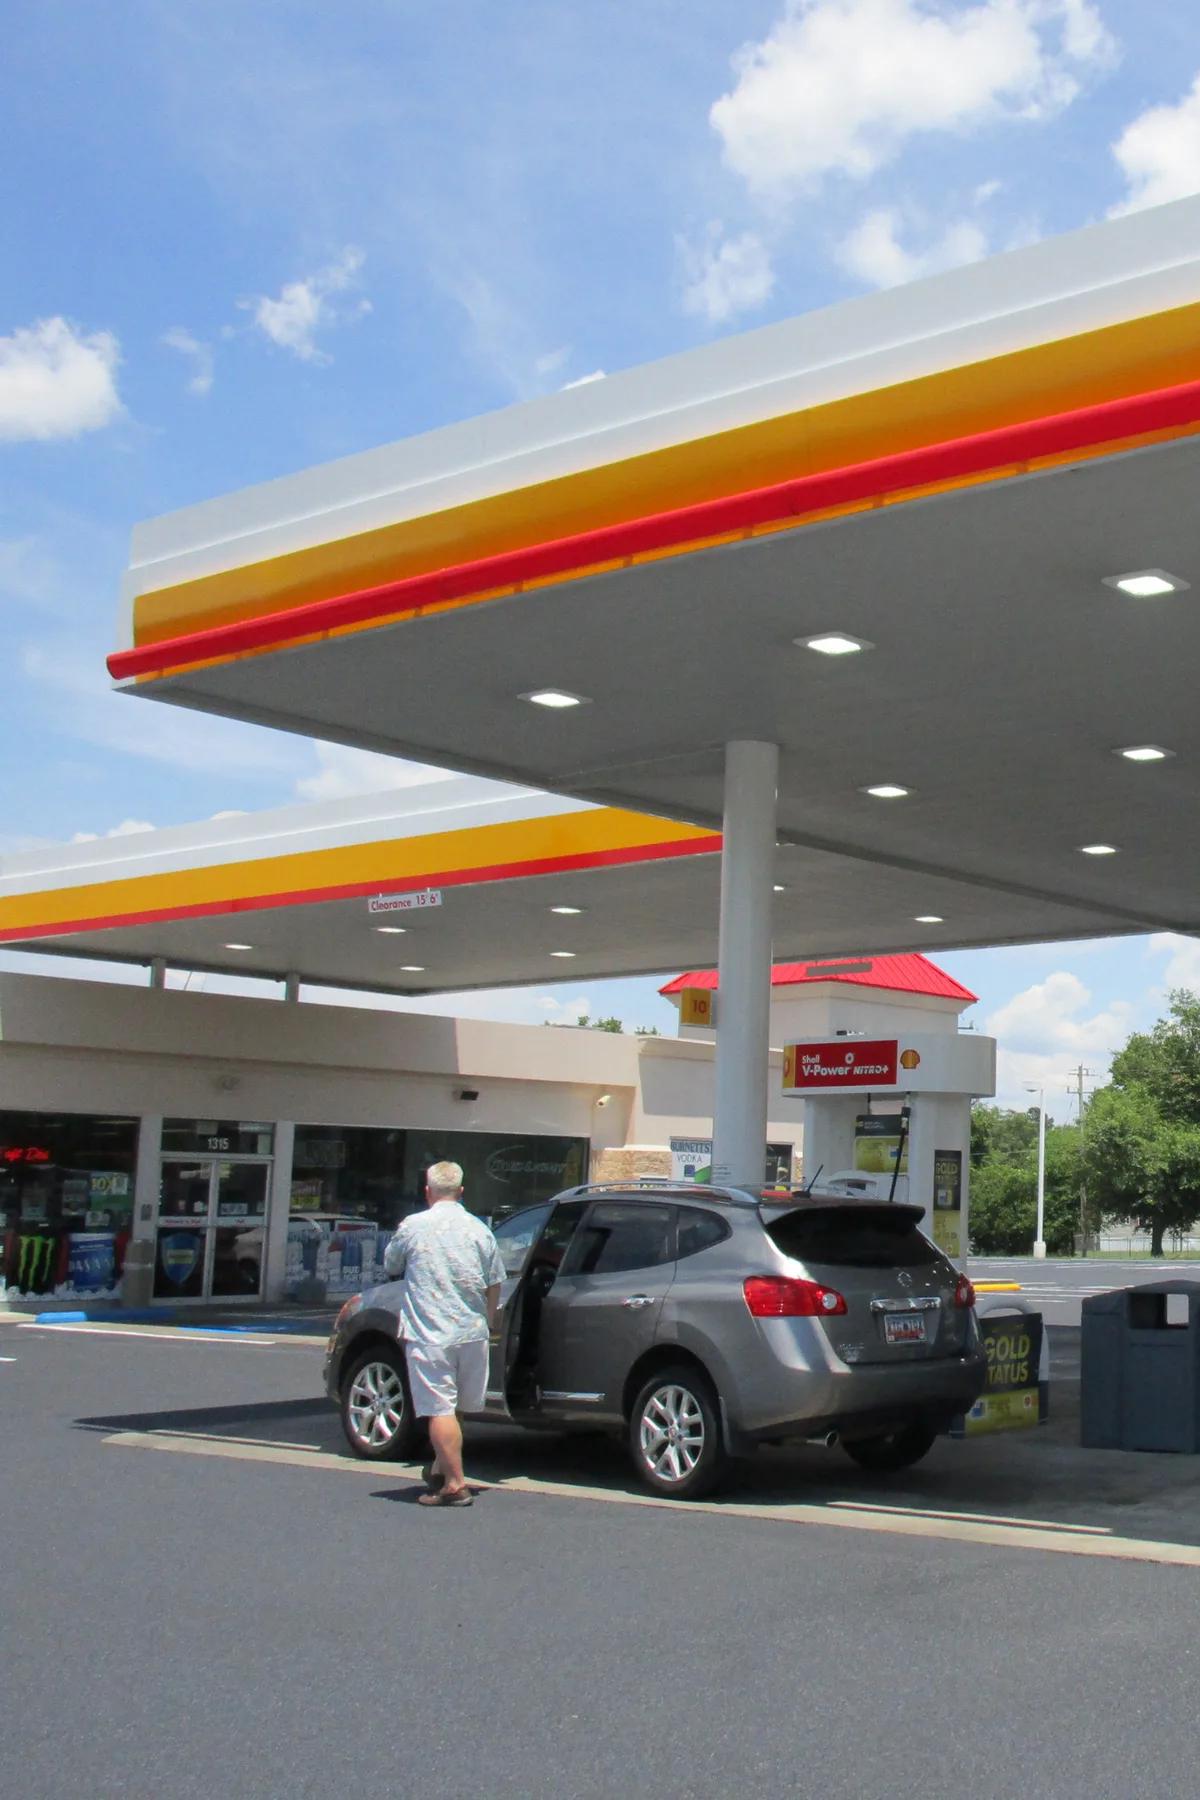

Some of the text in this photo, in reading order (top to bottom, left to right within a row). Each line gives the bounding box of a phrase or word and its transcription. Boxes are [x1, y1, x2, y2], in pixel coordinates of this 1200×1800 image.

[371, 899, 411, 911] Clearance
[692, 1000, 708, 1014] 10
[802, 1054, 820, 1064] Shell
[802, 1063, 850, 1076] V-Power
[207, 1137, 230, 1150] 1315
[676, 1153, 703, 1163] VODKA
[984, 1334, 1031, 1363] GOLD
[987, 1361, 1029, 1385] TATUS
